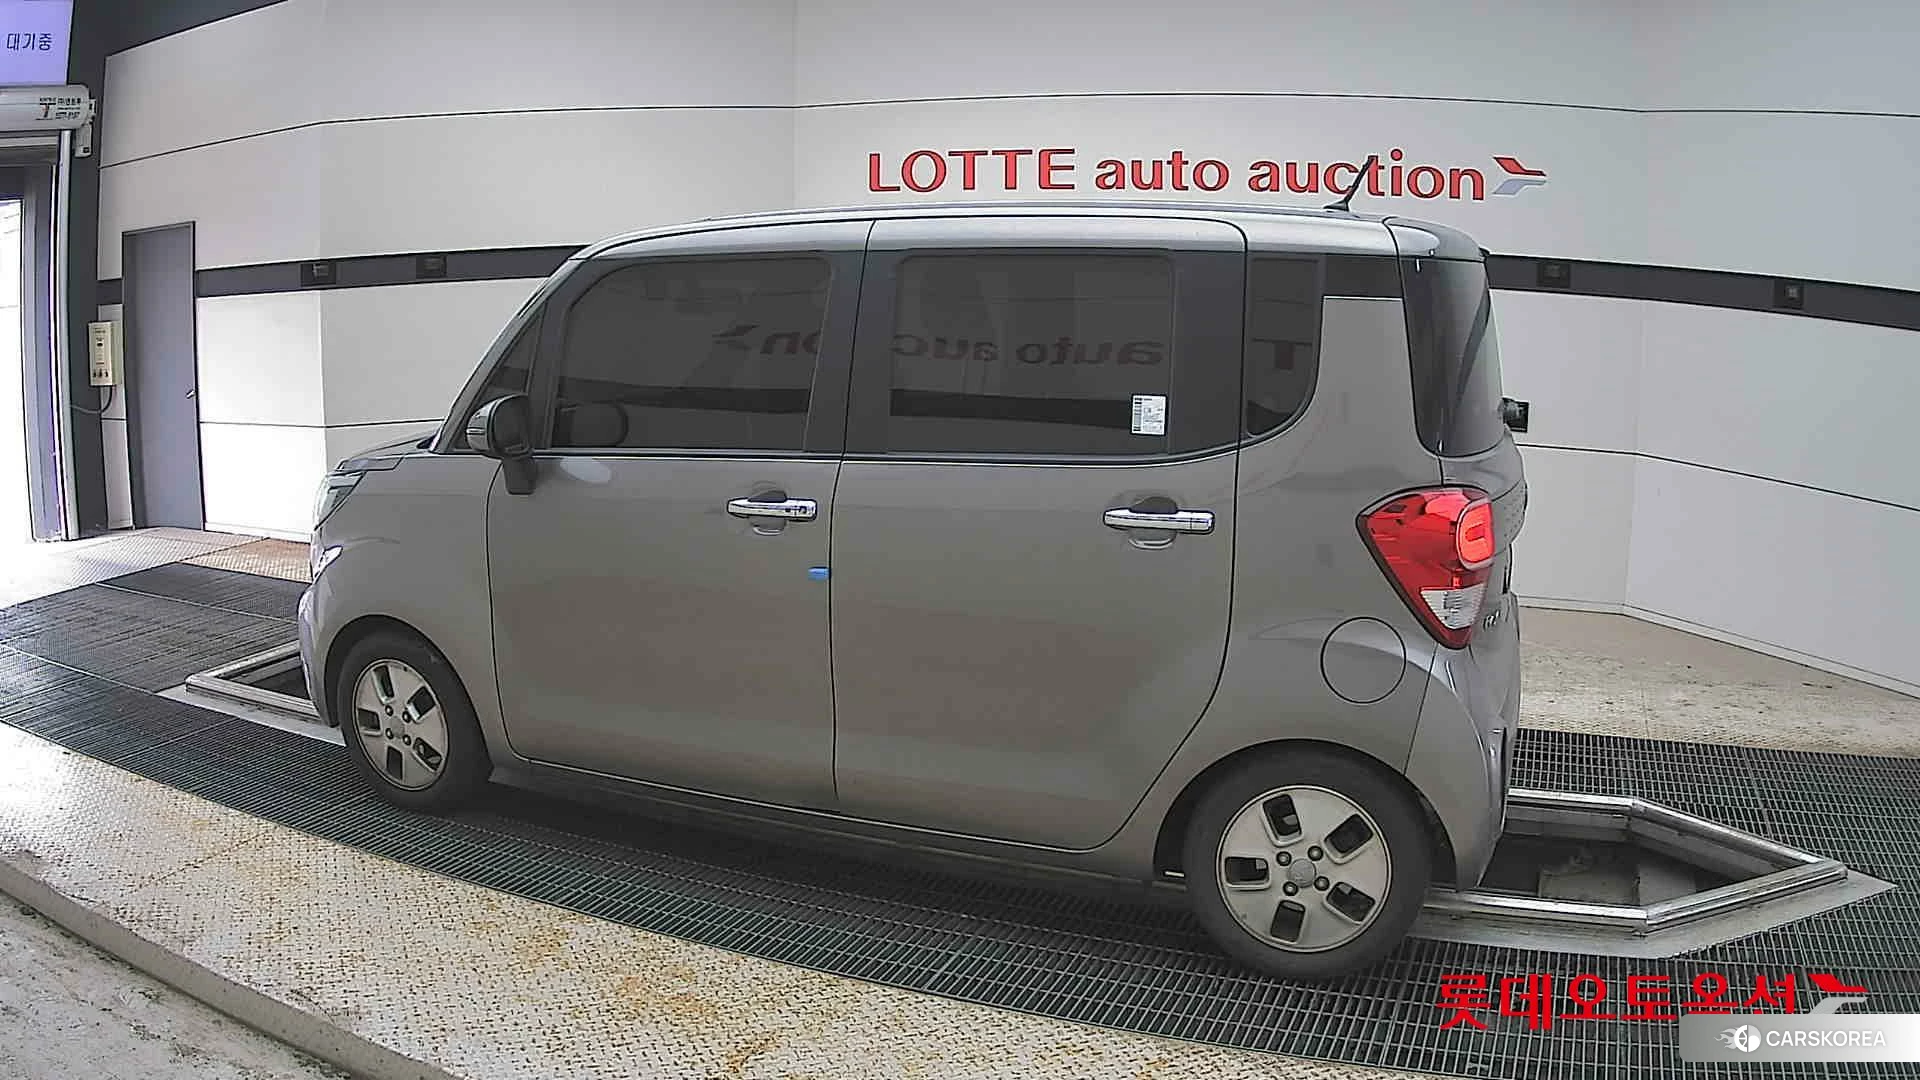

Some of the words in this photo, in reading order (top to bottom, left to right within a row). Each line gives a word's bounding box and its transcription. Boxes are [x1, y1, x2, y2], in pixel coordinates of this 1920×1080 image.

[6, 32, 53, 51] 대기중
[868, 148, 1076, 193] LOTTE
[1095, 150, 1231, 192] auto
[1247, 148, 1487, 201] auction
